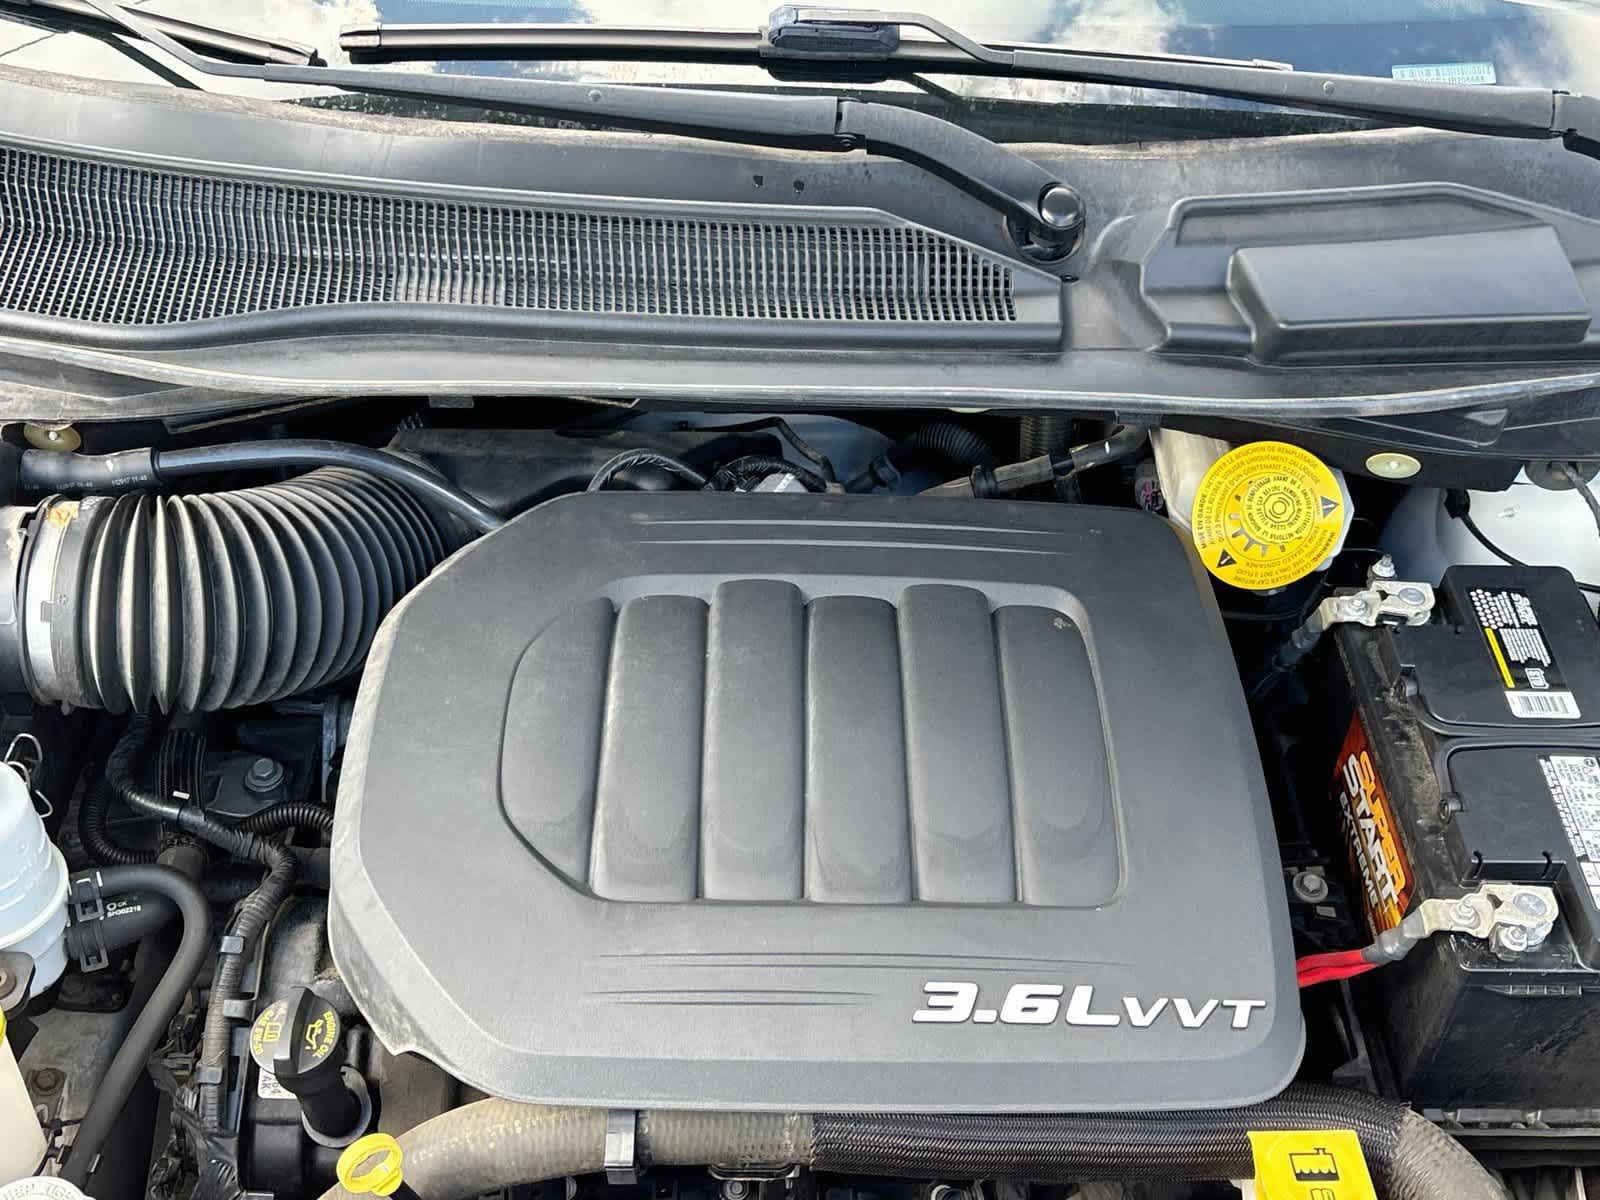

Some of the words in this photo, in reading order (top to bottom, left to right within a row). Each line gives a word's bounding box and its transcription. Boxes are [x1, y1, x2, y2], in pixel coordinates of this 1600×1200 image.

[1340, 791, 1379, 907] EXTREME
[1343, 754, 1399, 905] START
[1357, 751, 1405, 895] SUPER
[323, 1010, 336, 1045] ENGINE
[912, 982, 1121, 1026] 3.6L
[1122, 996, 1267, 1029] VVT
[312, 1044, 329, 1059] OIL
